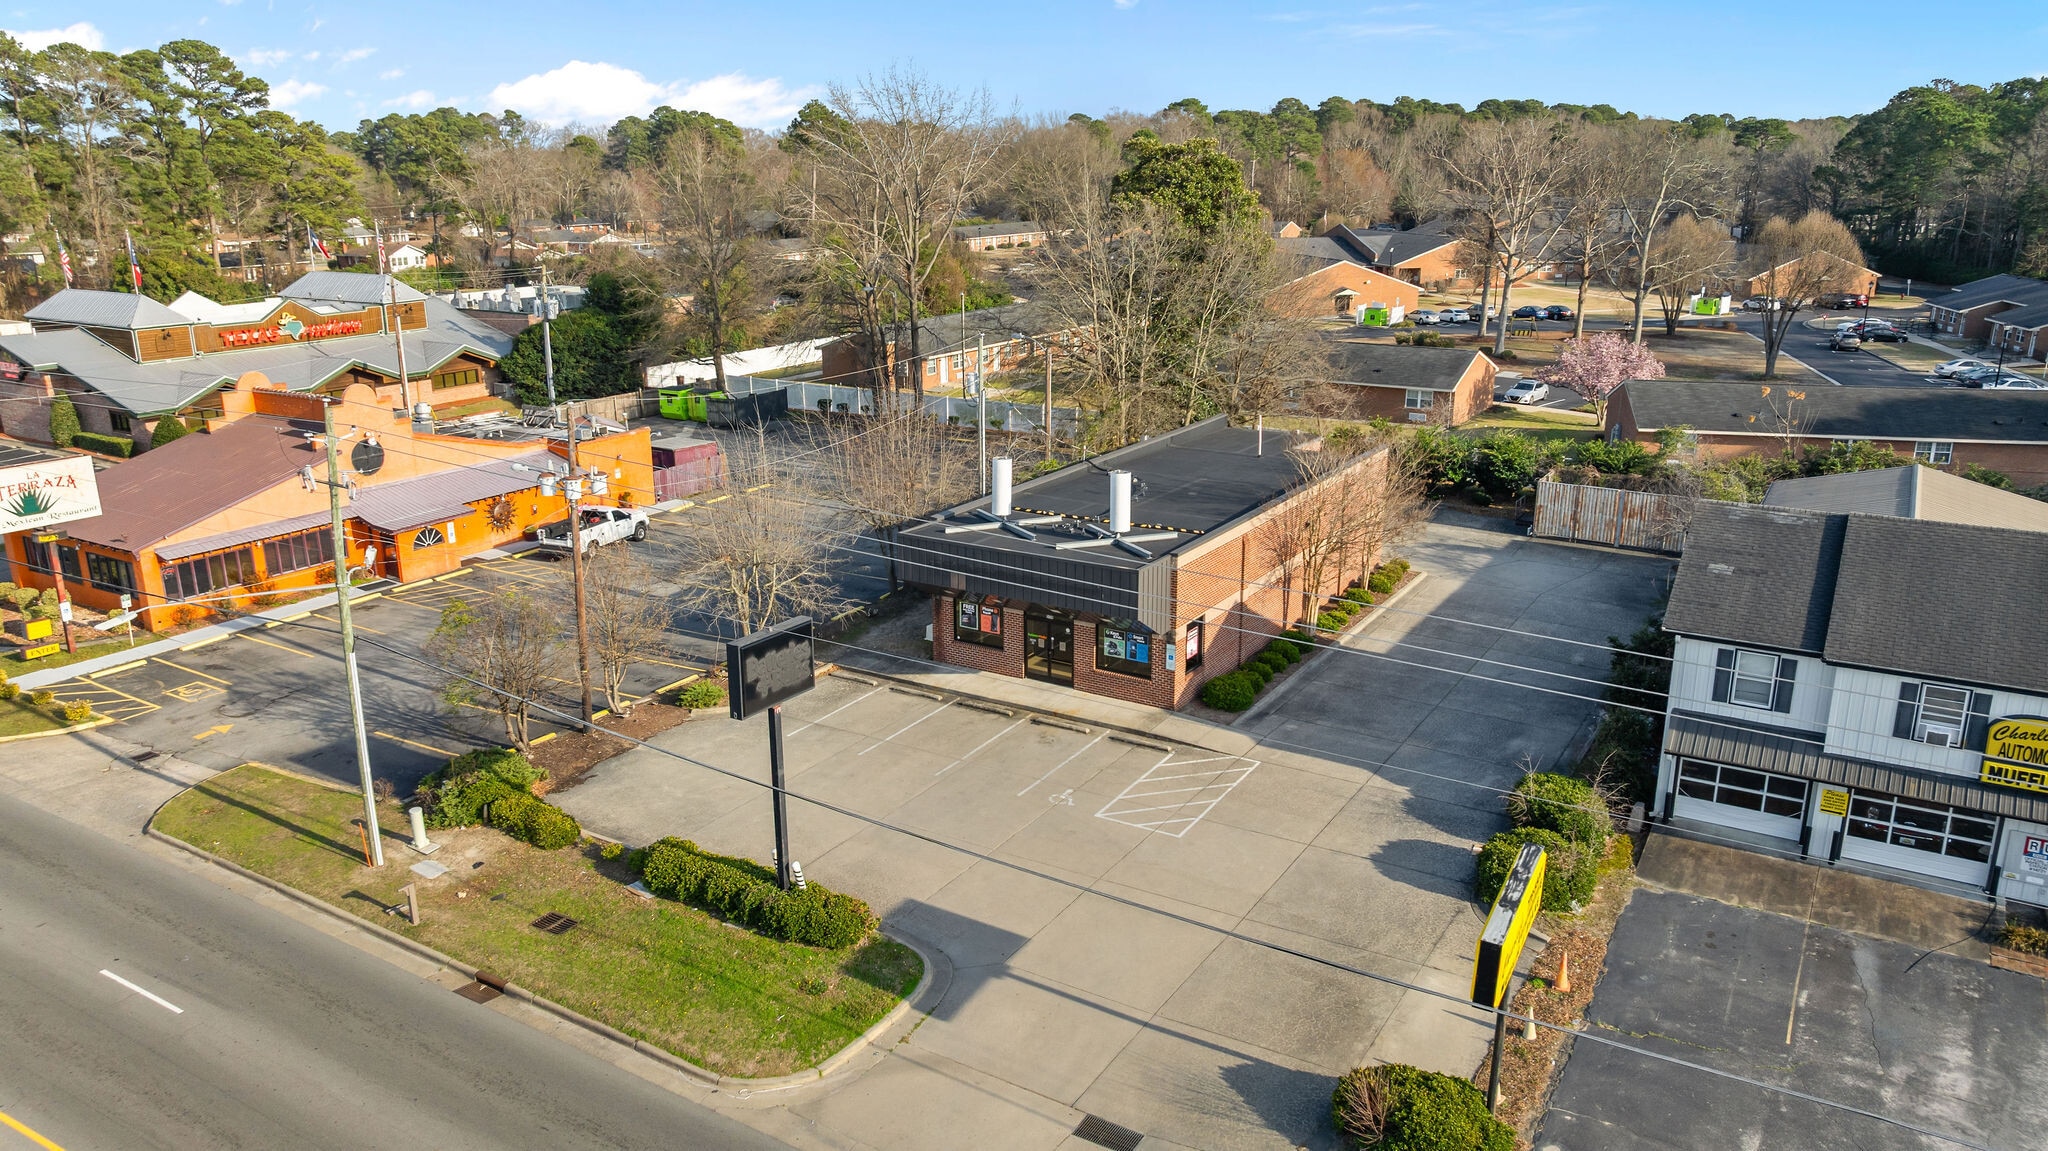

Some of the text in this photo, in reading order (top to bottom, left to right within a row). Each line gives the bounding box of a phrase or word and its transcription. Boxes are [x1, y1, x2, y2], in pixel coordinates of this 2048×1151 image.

[219, 325, 281, 347] TEXAS
[26, 471, 40, 480] LA
[2, 506, 97, 529] Mexican Restaurant
[31, 647, 56, 656] ENTER
[1987, 766, 2048, 789] MUFFL
